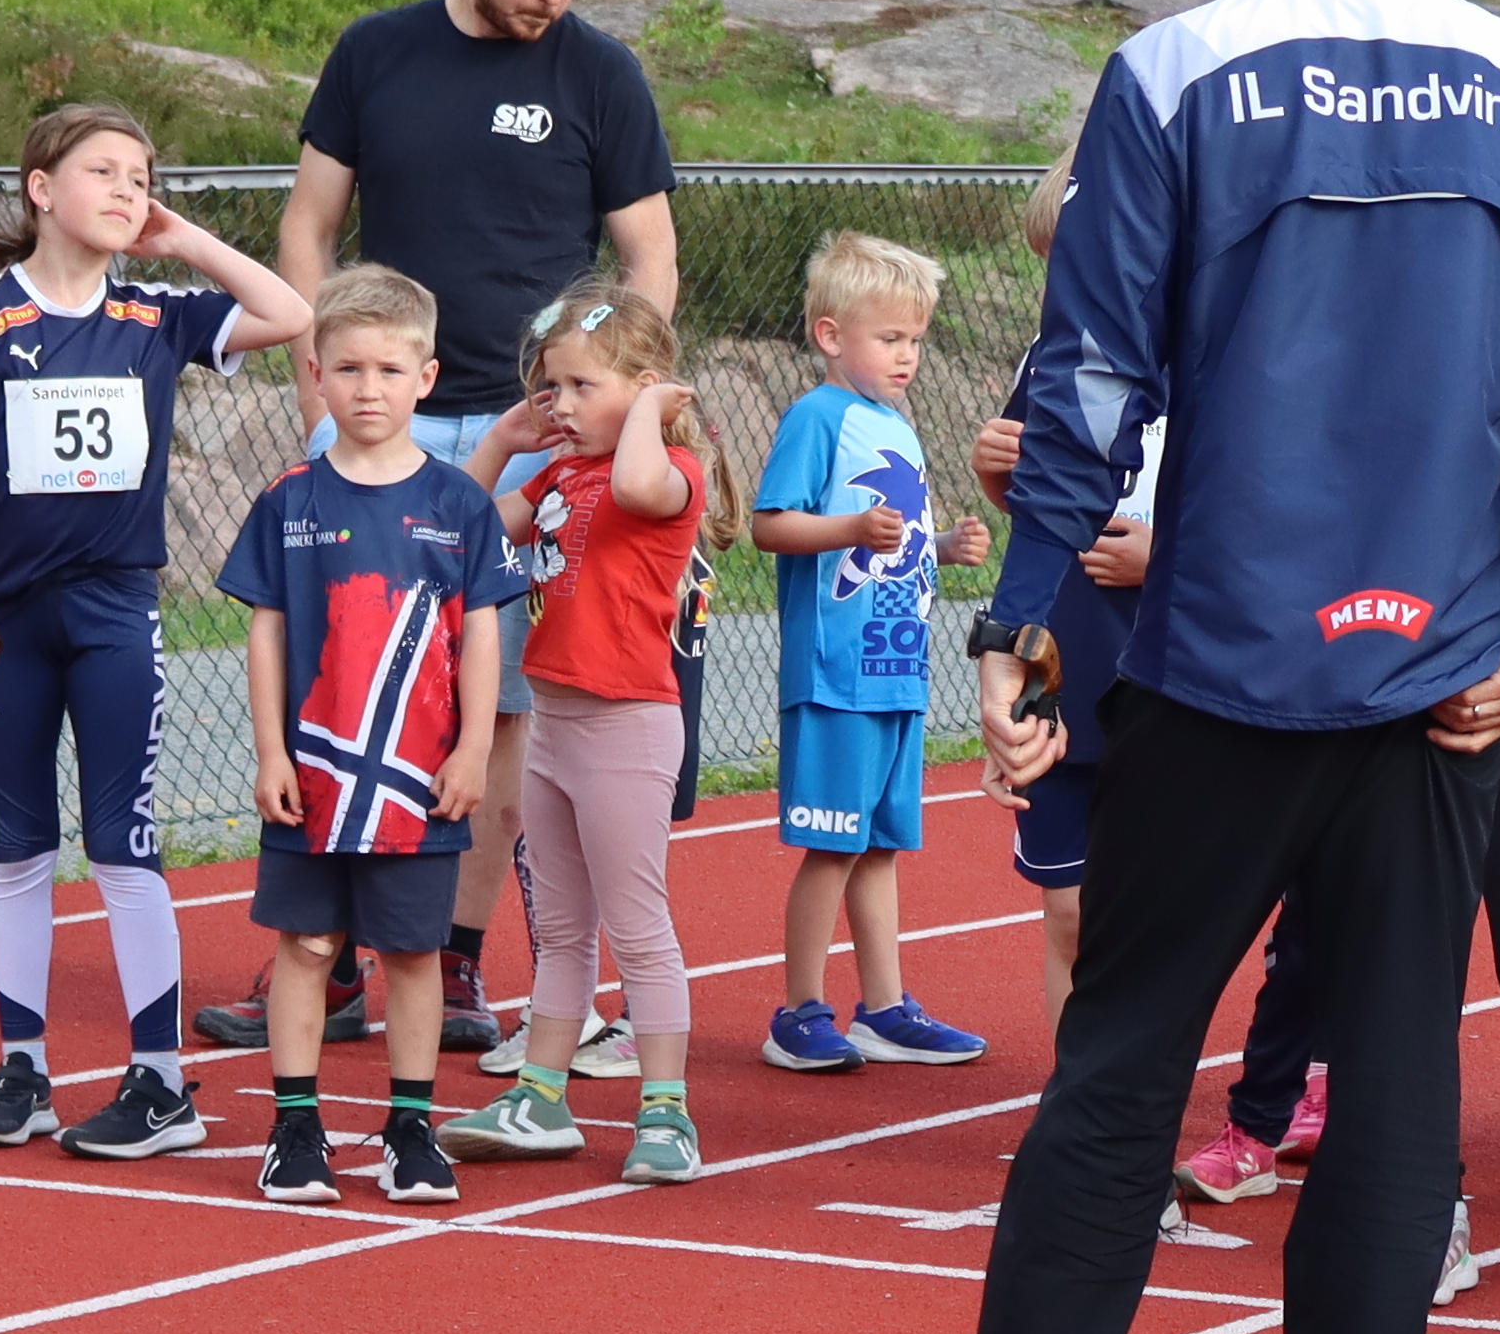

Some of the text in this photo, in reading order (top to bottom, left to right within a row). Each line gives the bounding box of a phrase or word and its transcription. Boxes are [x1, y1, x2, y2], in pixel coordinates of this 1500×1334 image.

[1228, 71, 1286, 124] IL
[493, 103, 546, 133] SM
[32, 385, 125, 402] Sandvinløpet
[53, 407, 114, 462] 53
[1329, 598, 1422, 630] MENY
[863, 661, 899, 674] THE
